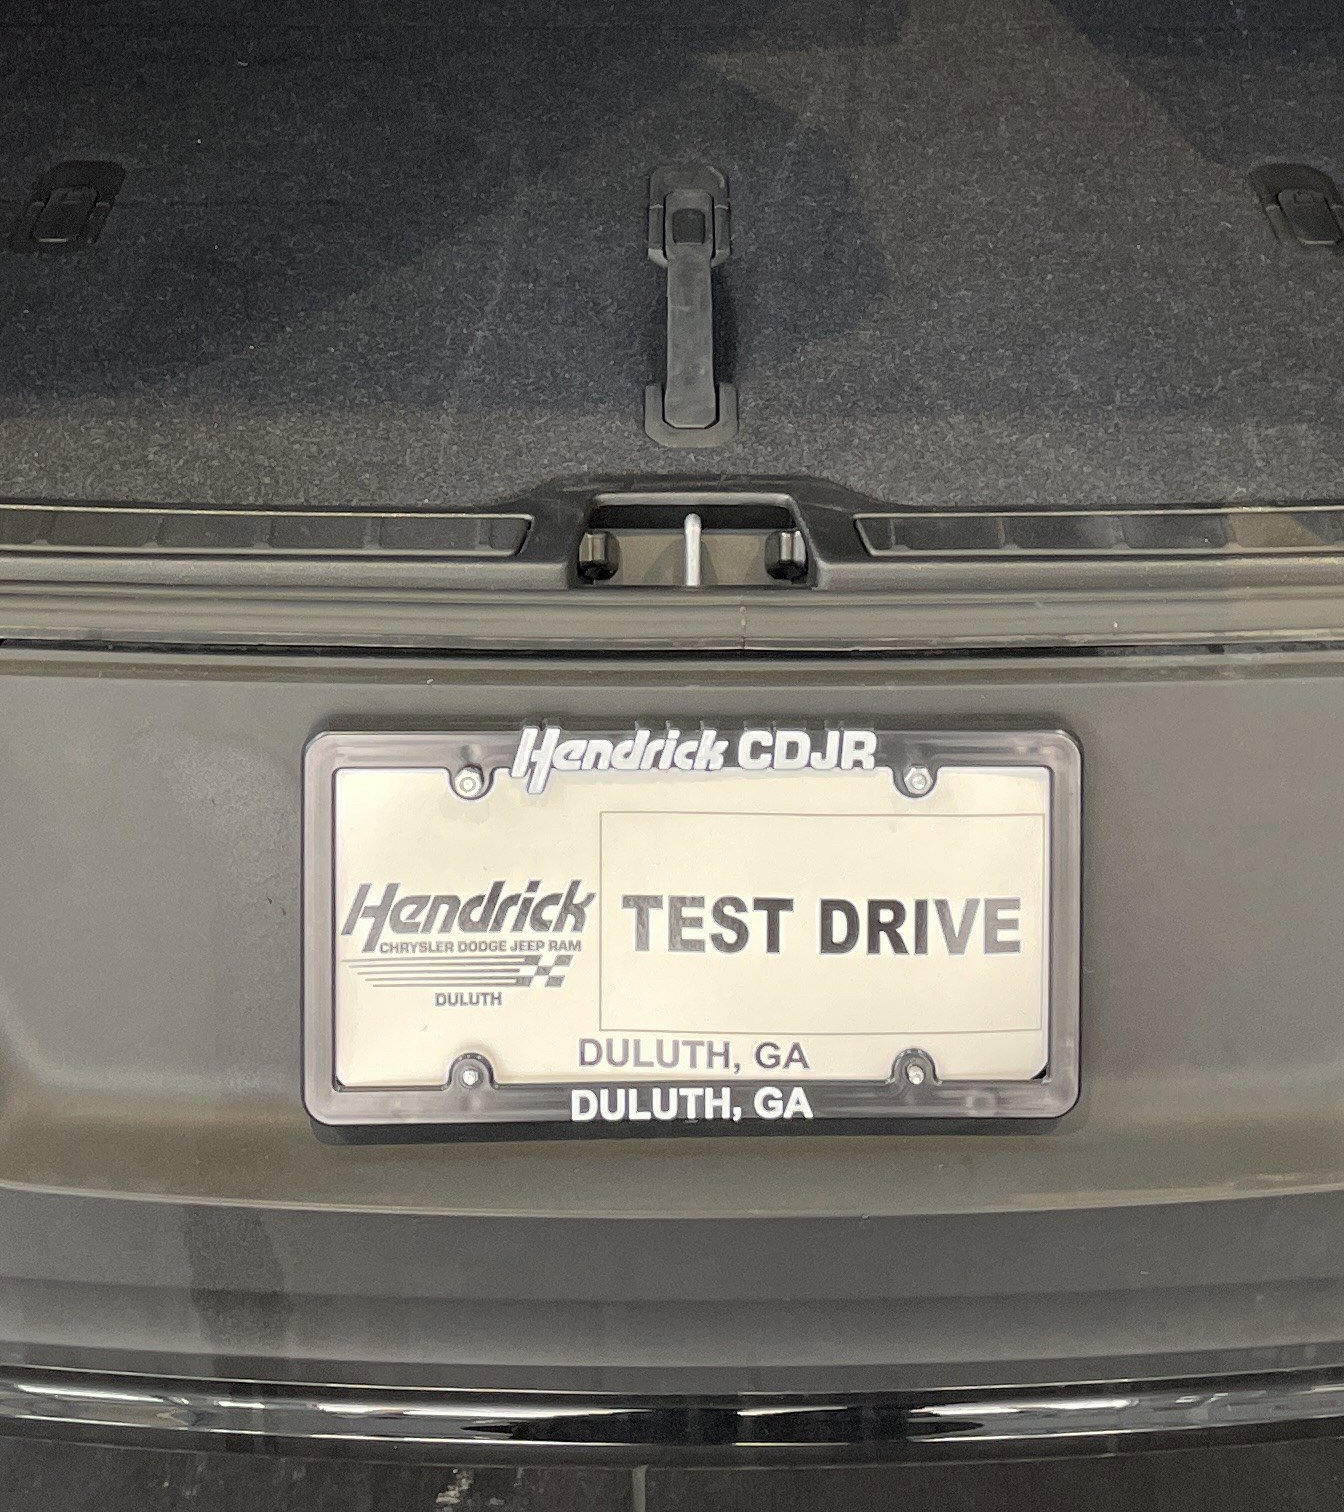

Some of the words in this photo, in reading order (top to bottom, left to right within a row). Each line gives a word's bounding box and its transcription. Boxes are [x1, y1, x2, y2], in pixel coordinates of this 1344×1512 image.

[511, 727, 729, 794] Hendrick
[737, 730, 877, 770] CDJR
[340, 879, 597, 953] Hendrick
[621, 894, 794, 955] TEST
[819, 897, 1022, 955] DRIVE
[380, 941, 454, 954] CHRYSLER
[458, 941, 507, 953] DODGE
[510, 940, 545, 953] JEEP
[548, 940, 582, 952] RAM
[434, 992, 503, 1007] DULUTH
[578, 1038, 742, 1074] DULUTH,
[755, 1041, 811, 1070] GA
[571, 1088, 742, 1123] DULUTH,
[753, 1086, 814, 1120] GA
